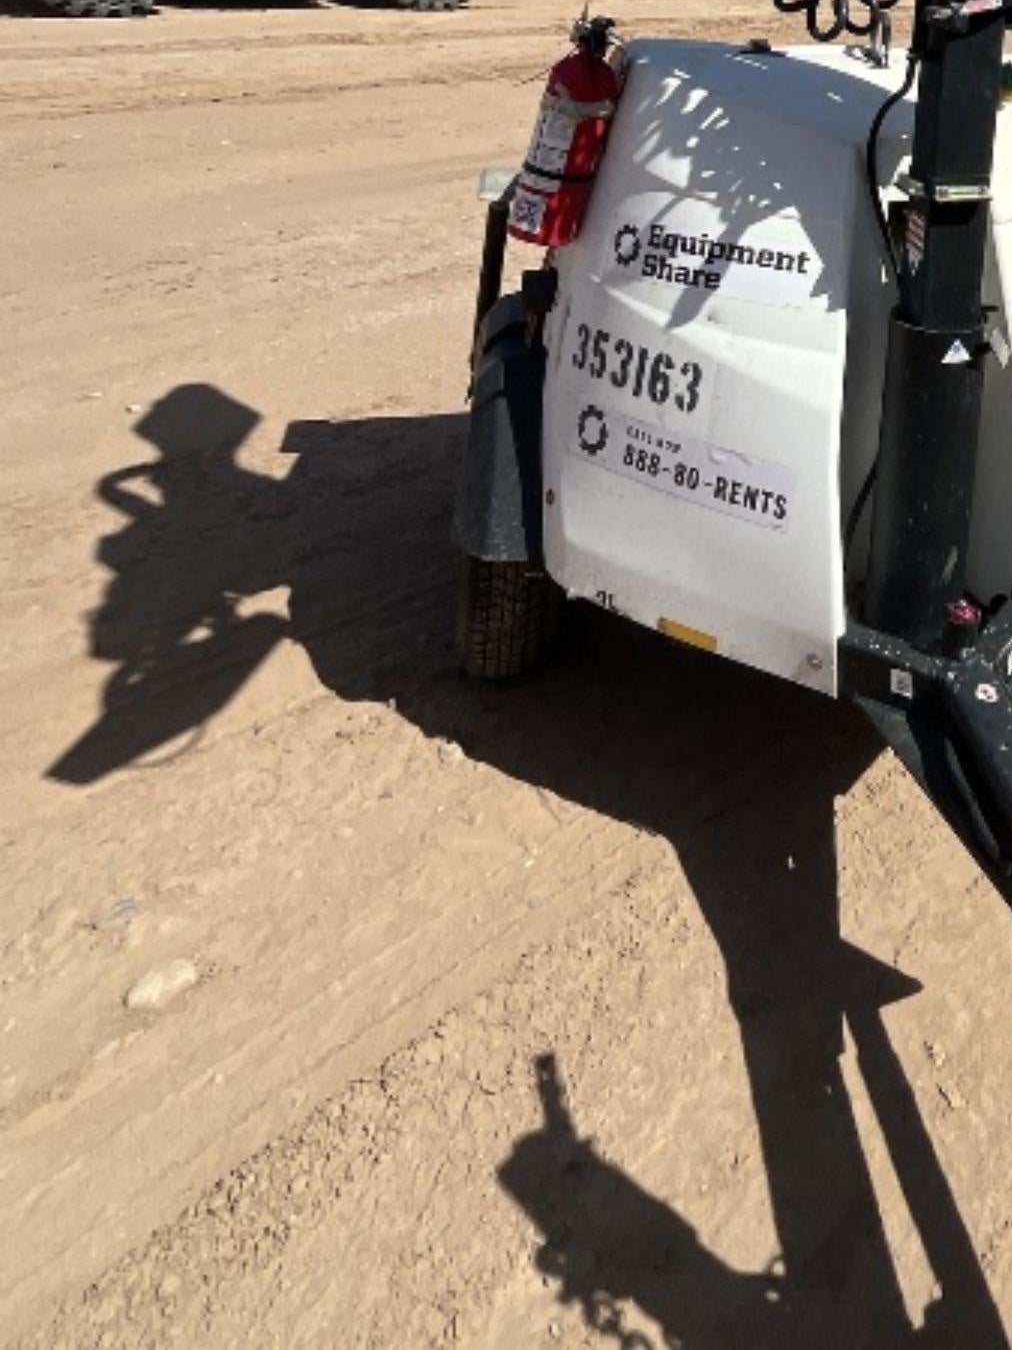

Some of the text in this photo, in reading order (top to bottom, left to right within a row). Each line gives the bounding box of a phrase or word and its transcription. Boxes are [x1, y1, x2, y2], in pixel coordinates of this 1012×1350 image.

[641, 254, 721, 289] Share
[647, 223, 811, 274] Equipment
[572, 323, 703, 414] 353163
[623, 443, 788, 520] 888-80-RENTS
